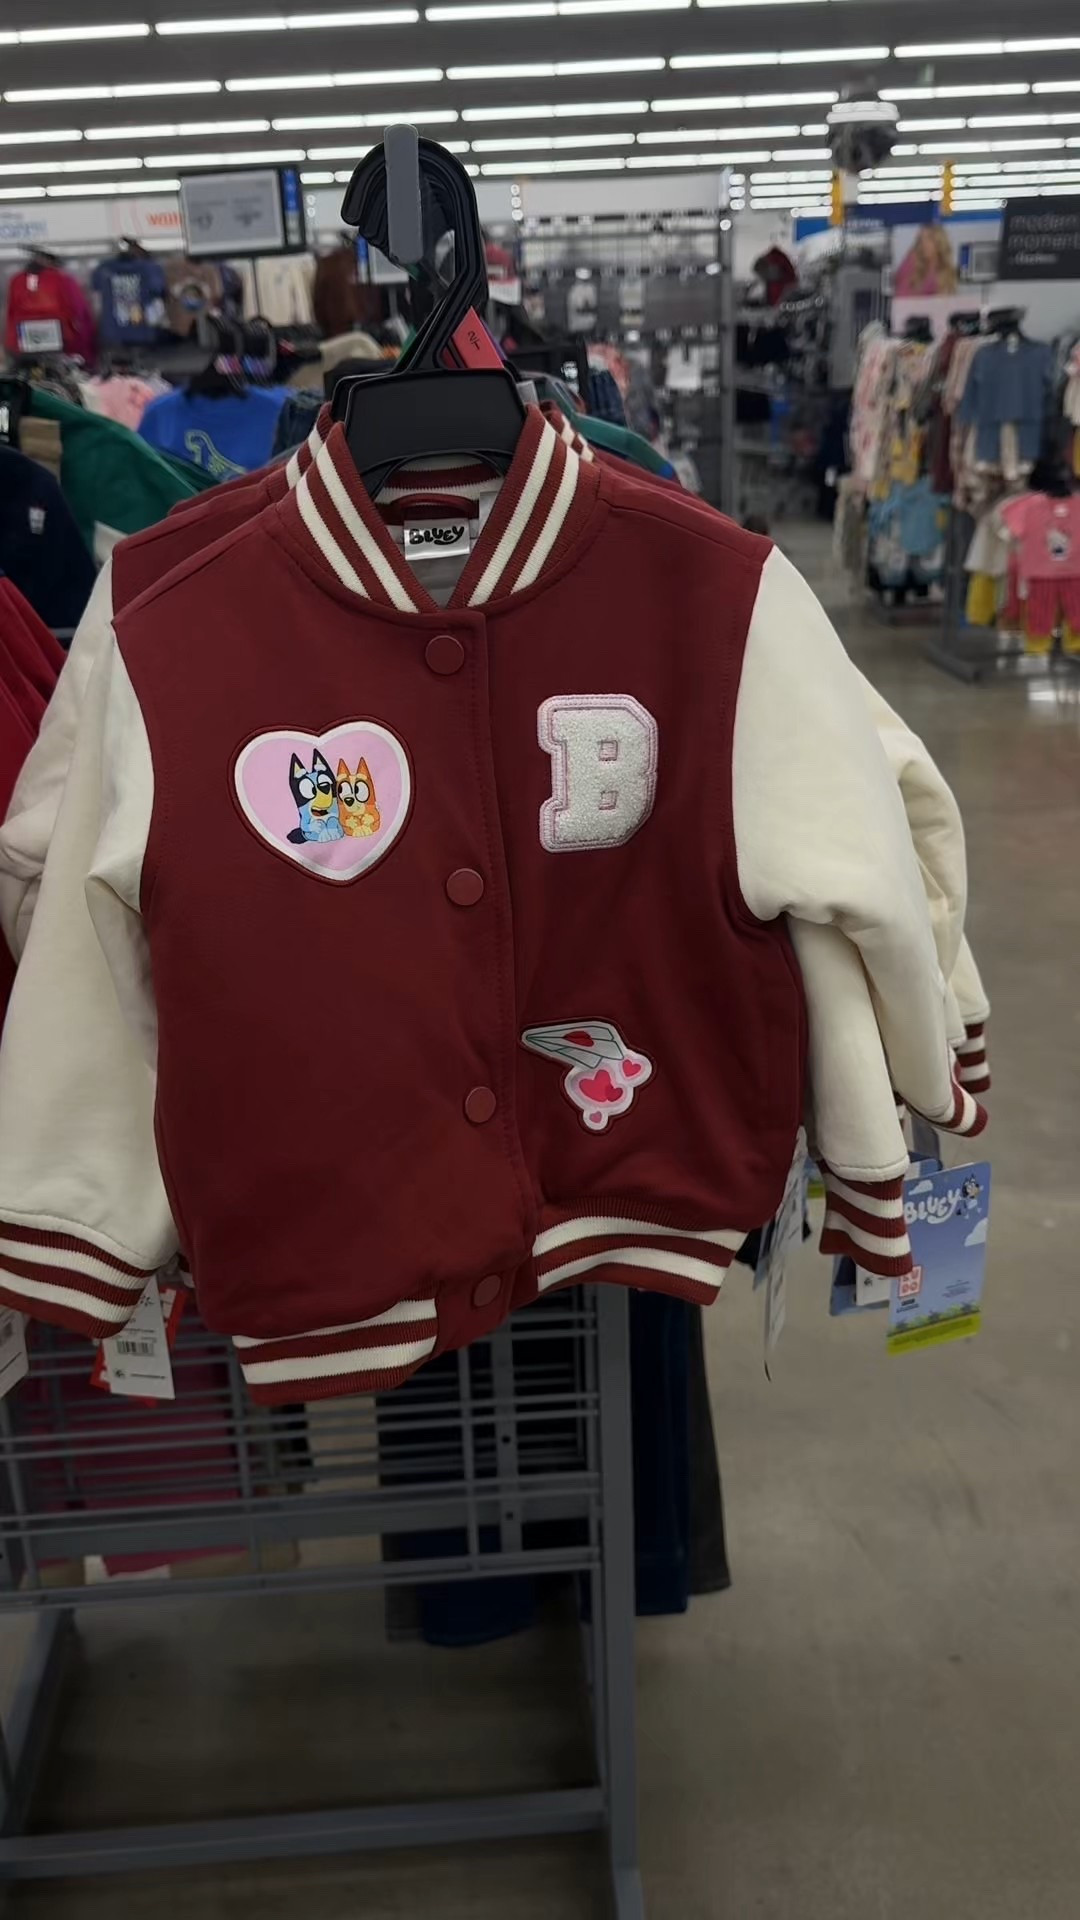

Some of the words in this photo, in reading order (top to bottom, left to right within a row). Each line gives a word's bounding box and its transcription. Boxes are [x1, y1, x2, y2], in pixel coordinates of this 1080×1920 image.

[409, 525, 465, 546] BLUEY
[537, 694, 658, 853] B
[904, 1188, 961, 1224] BLUEY
